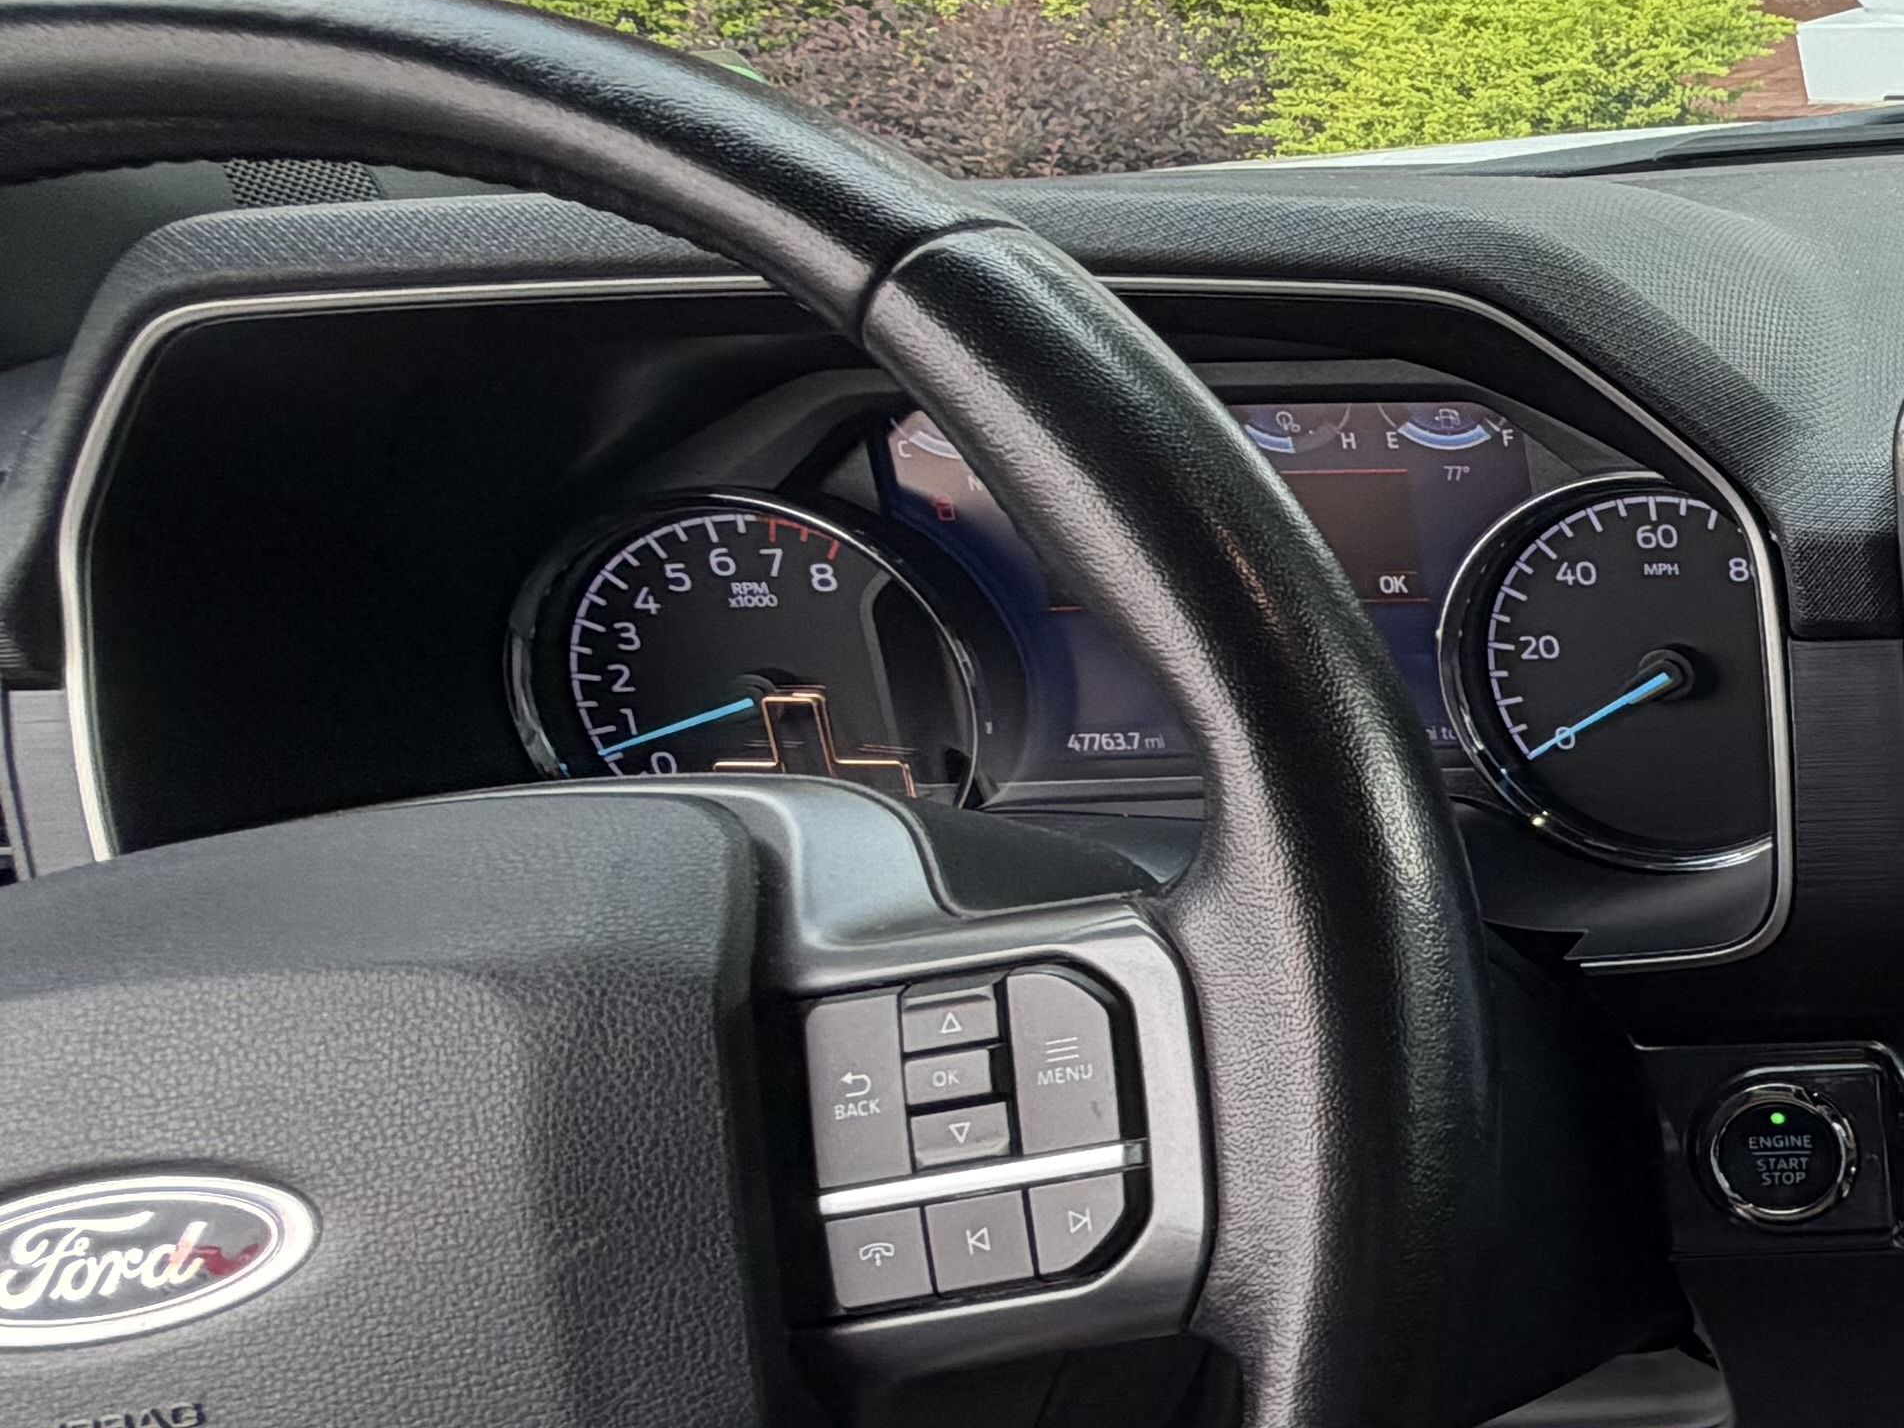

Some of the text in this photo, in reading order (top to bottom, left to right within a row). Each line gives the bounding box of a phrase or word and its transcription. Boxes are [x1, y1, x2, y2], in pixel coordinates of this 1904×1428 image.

[1340, 432, 1358, 450] H
[1386, 431, 1400, 450] E
[1501, 428, 1515, 447] F
[1443, 465, 1470, 482] 77°
[1635, 524, 1679, 550] 60
[709, 548, 737, 577] 6
[759, 548, 785, 577] 7
[1555, 560, 1598, 587] 40
[1643, 561, 1680, 577] MPH
[664, 563, 693, 593] 5
[731, 580, 771, 597] RPM
[809, 562, 839, 593] 8
[1379, 575, 1409, 595] OK
[633, 586, 661, 615] 4
[729, 593, 779, 610] x1000
[613, 623, 642, 652] 3
[1518, 635, 1560, 661] 20
[606, 664, 637, 694] 2
[619, 708, 639, 736] 1
[1067, 731, 1165, 753] 47763.7 mi
[1554, 725, 1577, 751] 0
[931, 1070, 961, 1088] OK
[1036, 1063, 1094, 1087] MENU
[833, 1098, 882, 1121] BACK
[1748, 1134, 1813, 1150] ENGINE
[1755, 1157, 1810, 1172] START
[1760, 1171, 1807, 1187] STOP
[0, 1210, 209, 1310] Ford
